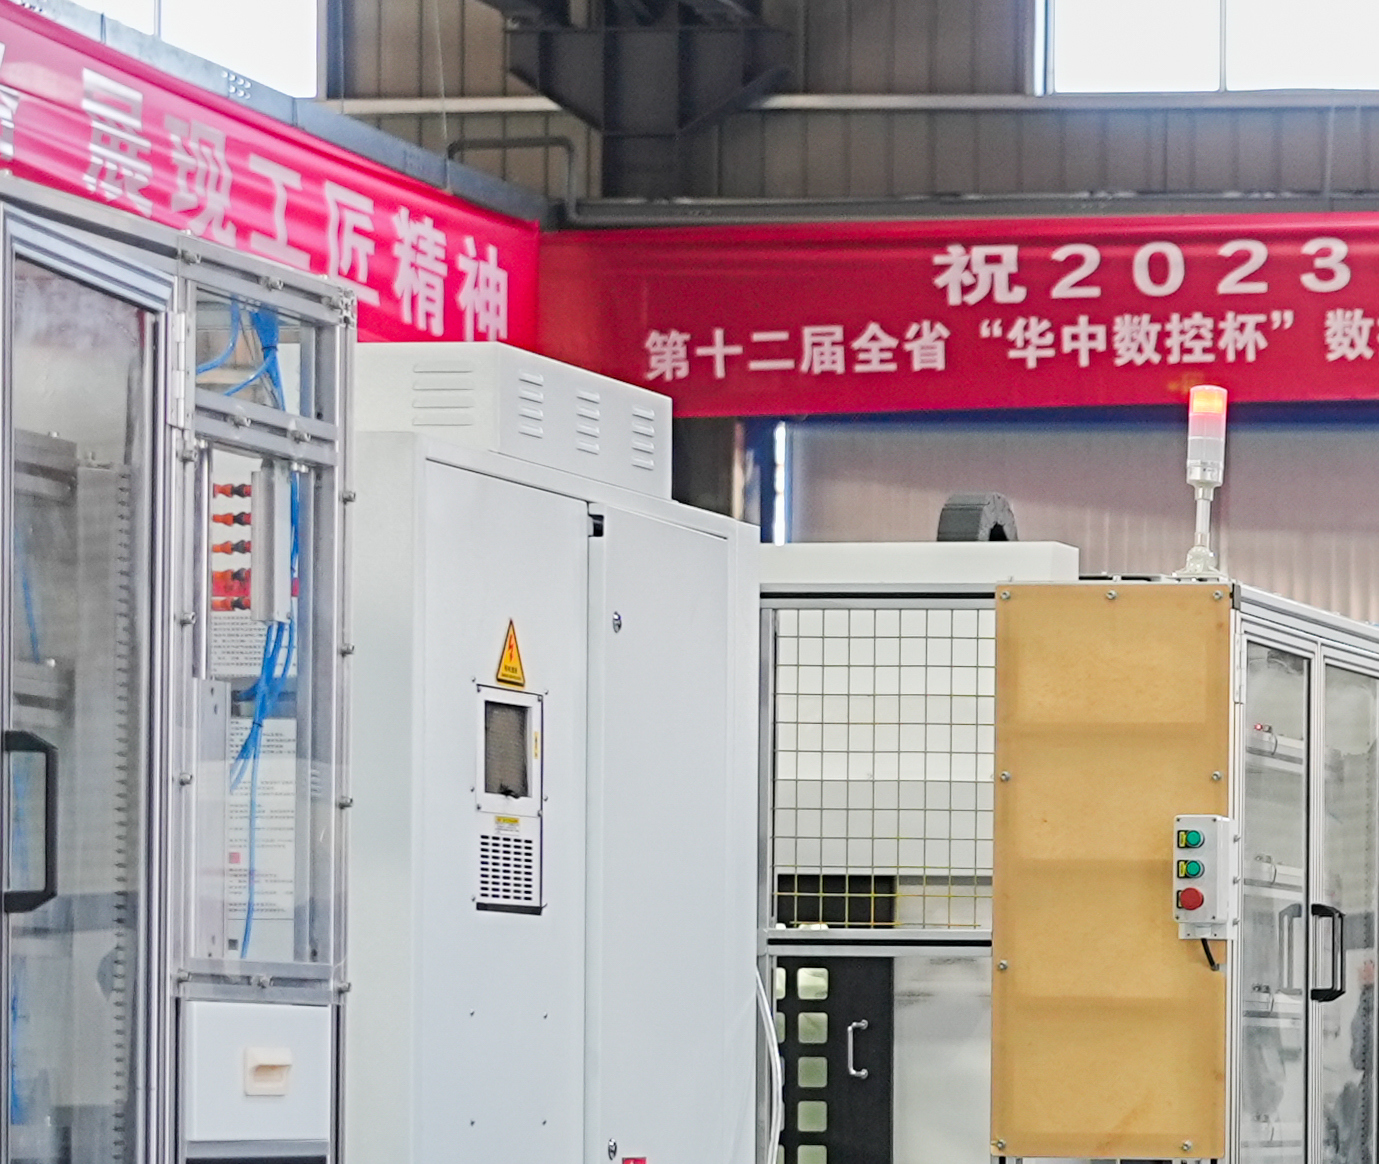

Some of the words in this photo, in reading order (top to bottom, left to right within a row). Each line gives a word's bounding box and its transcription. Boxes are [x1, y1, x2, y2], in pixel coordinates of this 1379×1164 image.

[82, 67, 509, 343] 展现工匠精神
